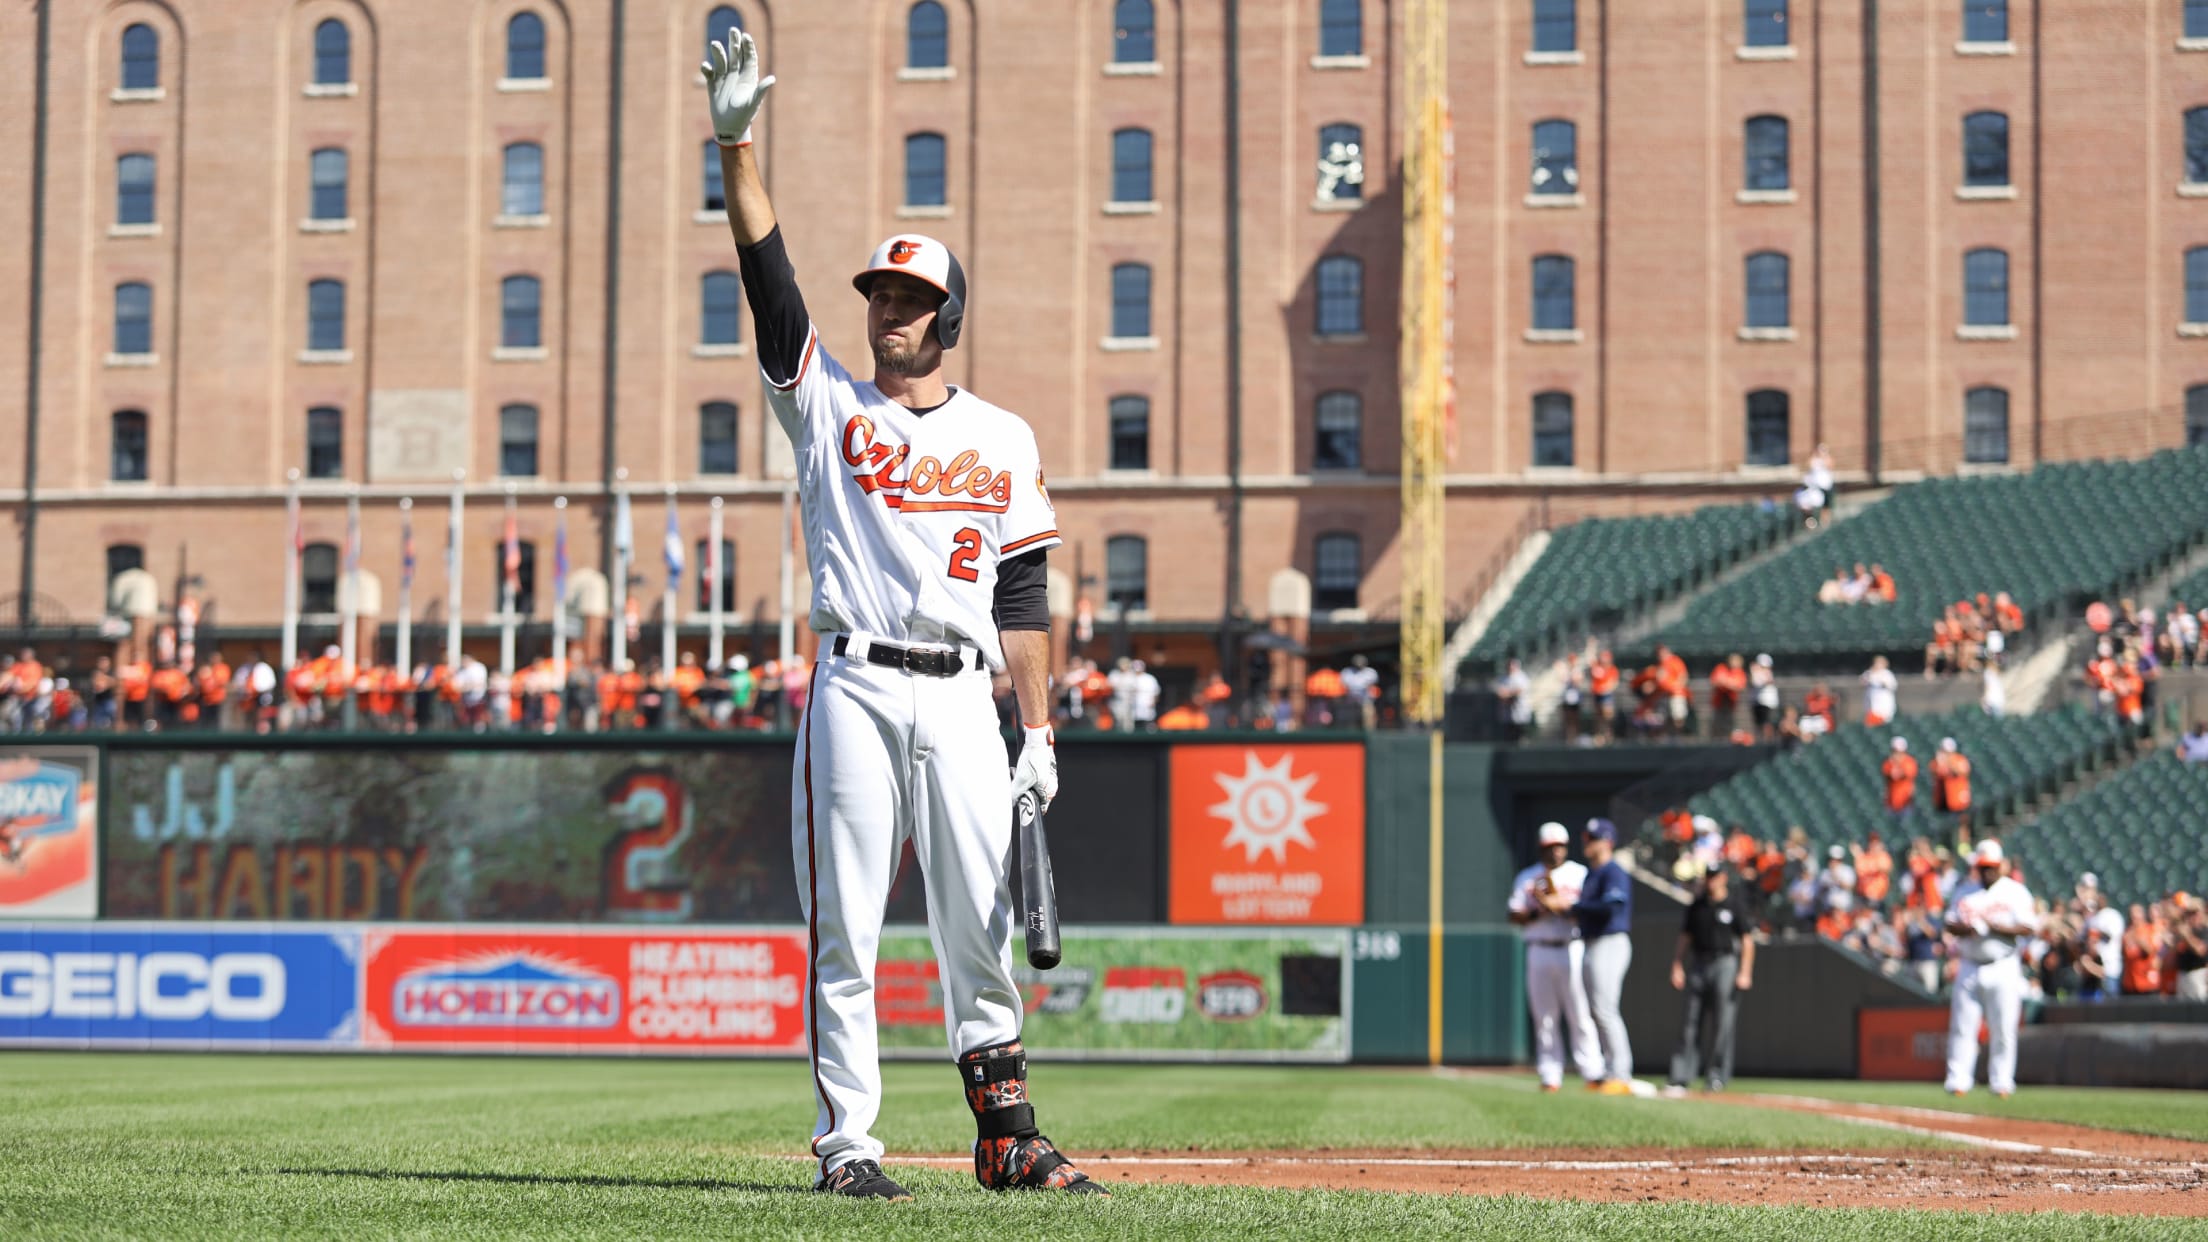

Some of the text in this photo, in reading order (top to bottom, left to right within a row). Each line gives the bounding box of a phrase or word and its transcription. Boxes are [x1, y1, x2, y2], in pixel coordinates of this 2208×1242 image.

[842, 414, 1012, 503] Orioles
[947, 526, 982, 583] 2
[159, 845, 428, 919] HARDY
[1211, 873, 1322, 896] MARYLAND
[1222, 896, 1312, 918] LOTTERY
[629, 944, 774, 972] HEATING
[0, 952, 287, 1021] GEICO
[629, 976, 800, 1007] PLUMBING
[403, 987, 611, 1018] HORIZON
[628, 1007, 775, 1037] COOLING
